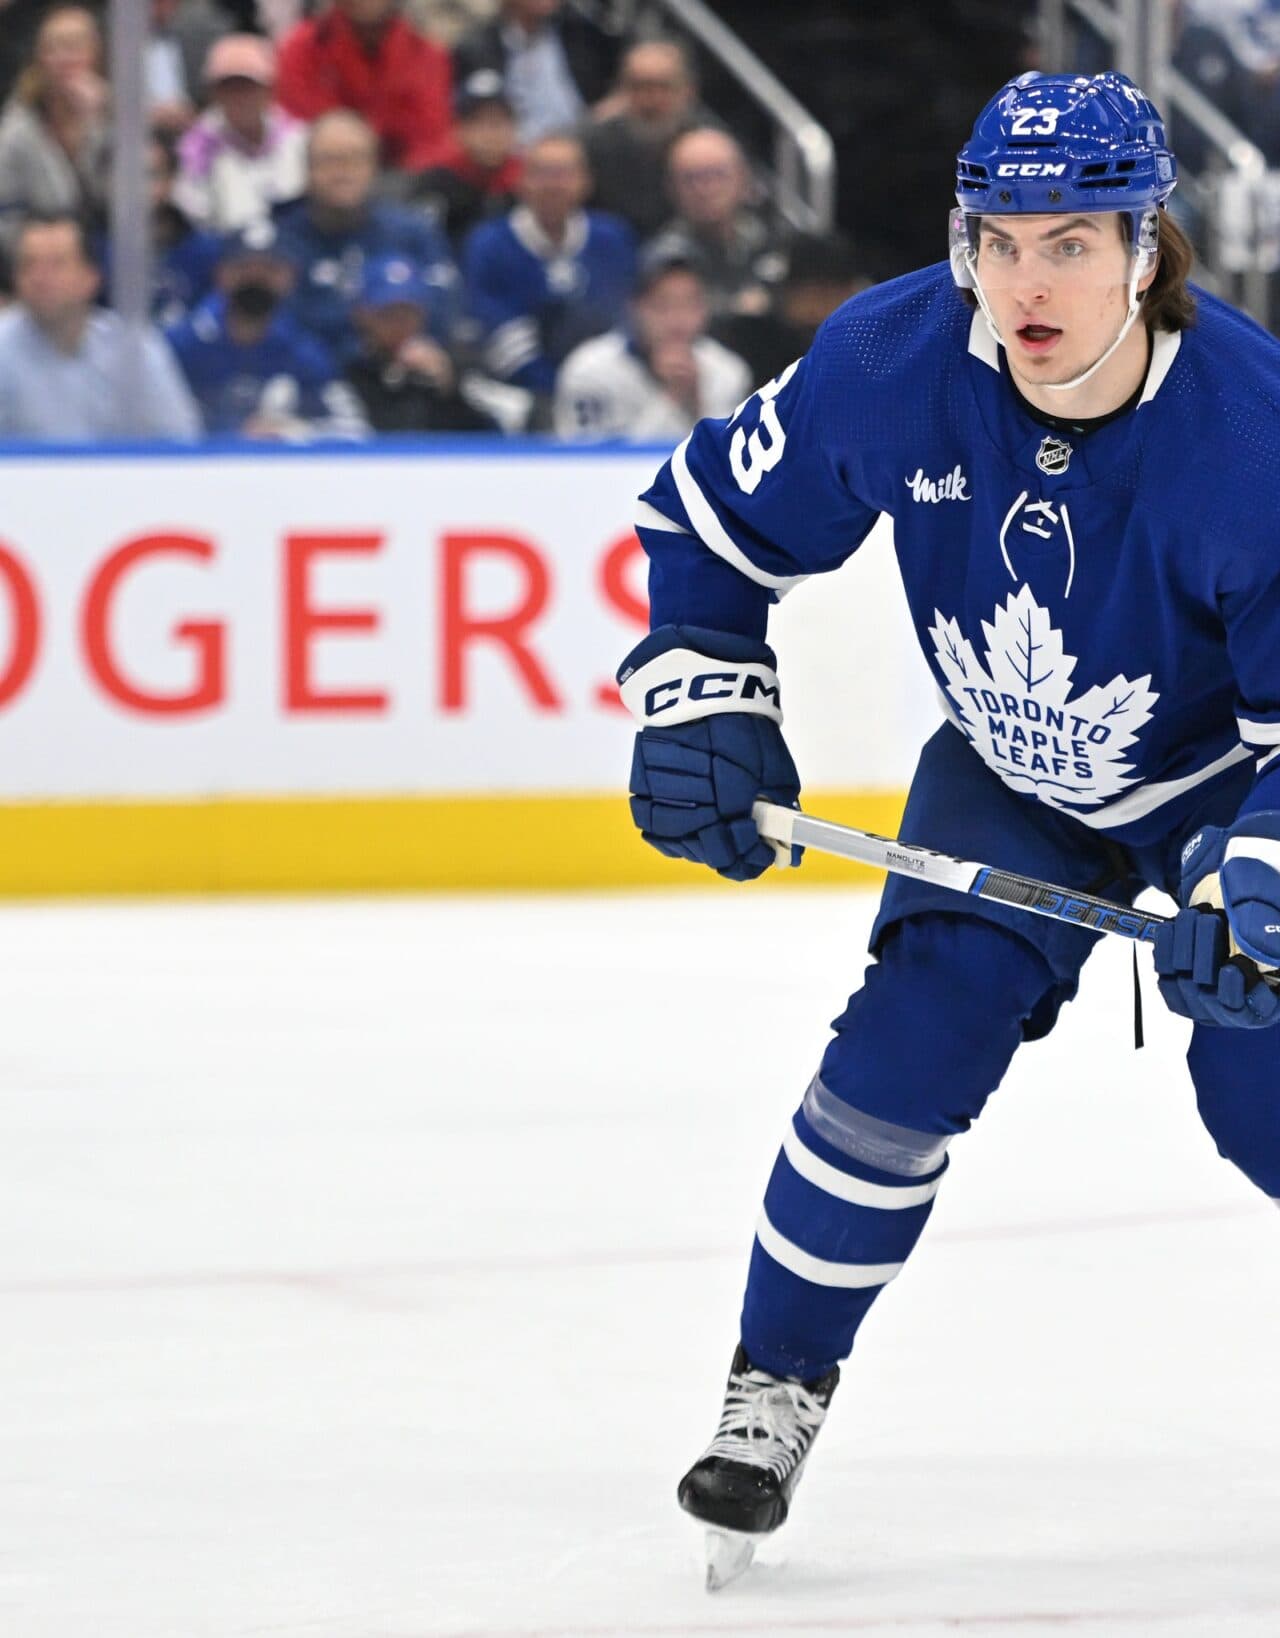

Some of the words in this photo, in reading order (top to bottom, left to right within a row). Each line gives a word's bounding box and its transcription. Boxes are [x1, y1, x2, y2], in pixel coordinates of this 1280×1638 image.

[1011, 108, 1060, 135] 23
[998, 163, 1066, 177] CCM
[905, 465, 972, 503] Milk
[645, 673, 780, 717] CCM
[963, 687, 1111, 745] TORONTO
[988, 715, 1089, 759] MAPLE
[991, 738, 1093, 779] LEAFS
